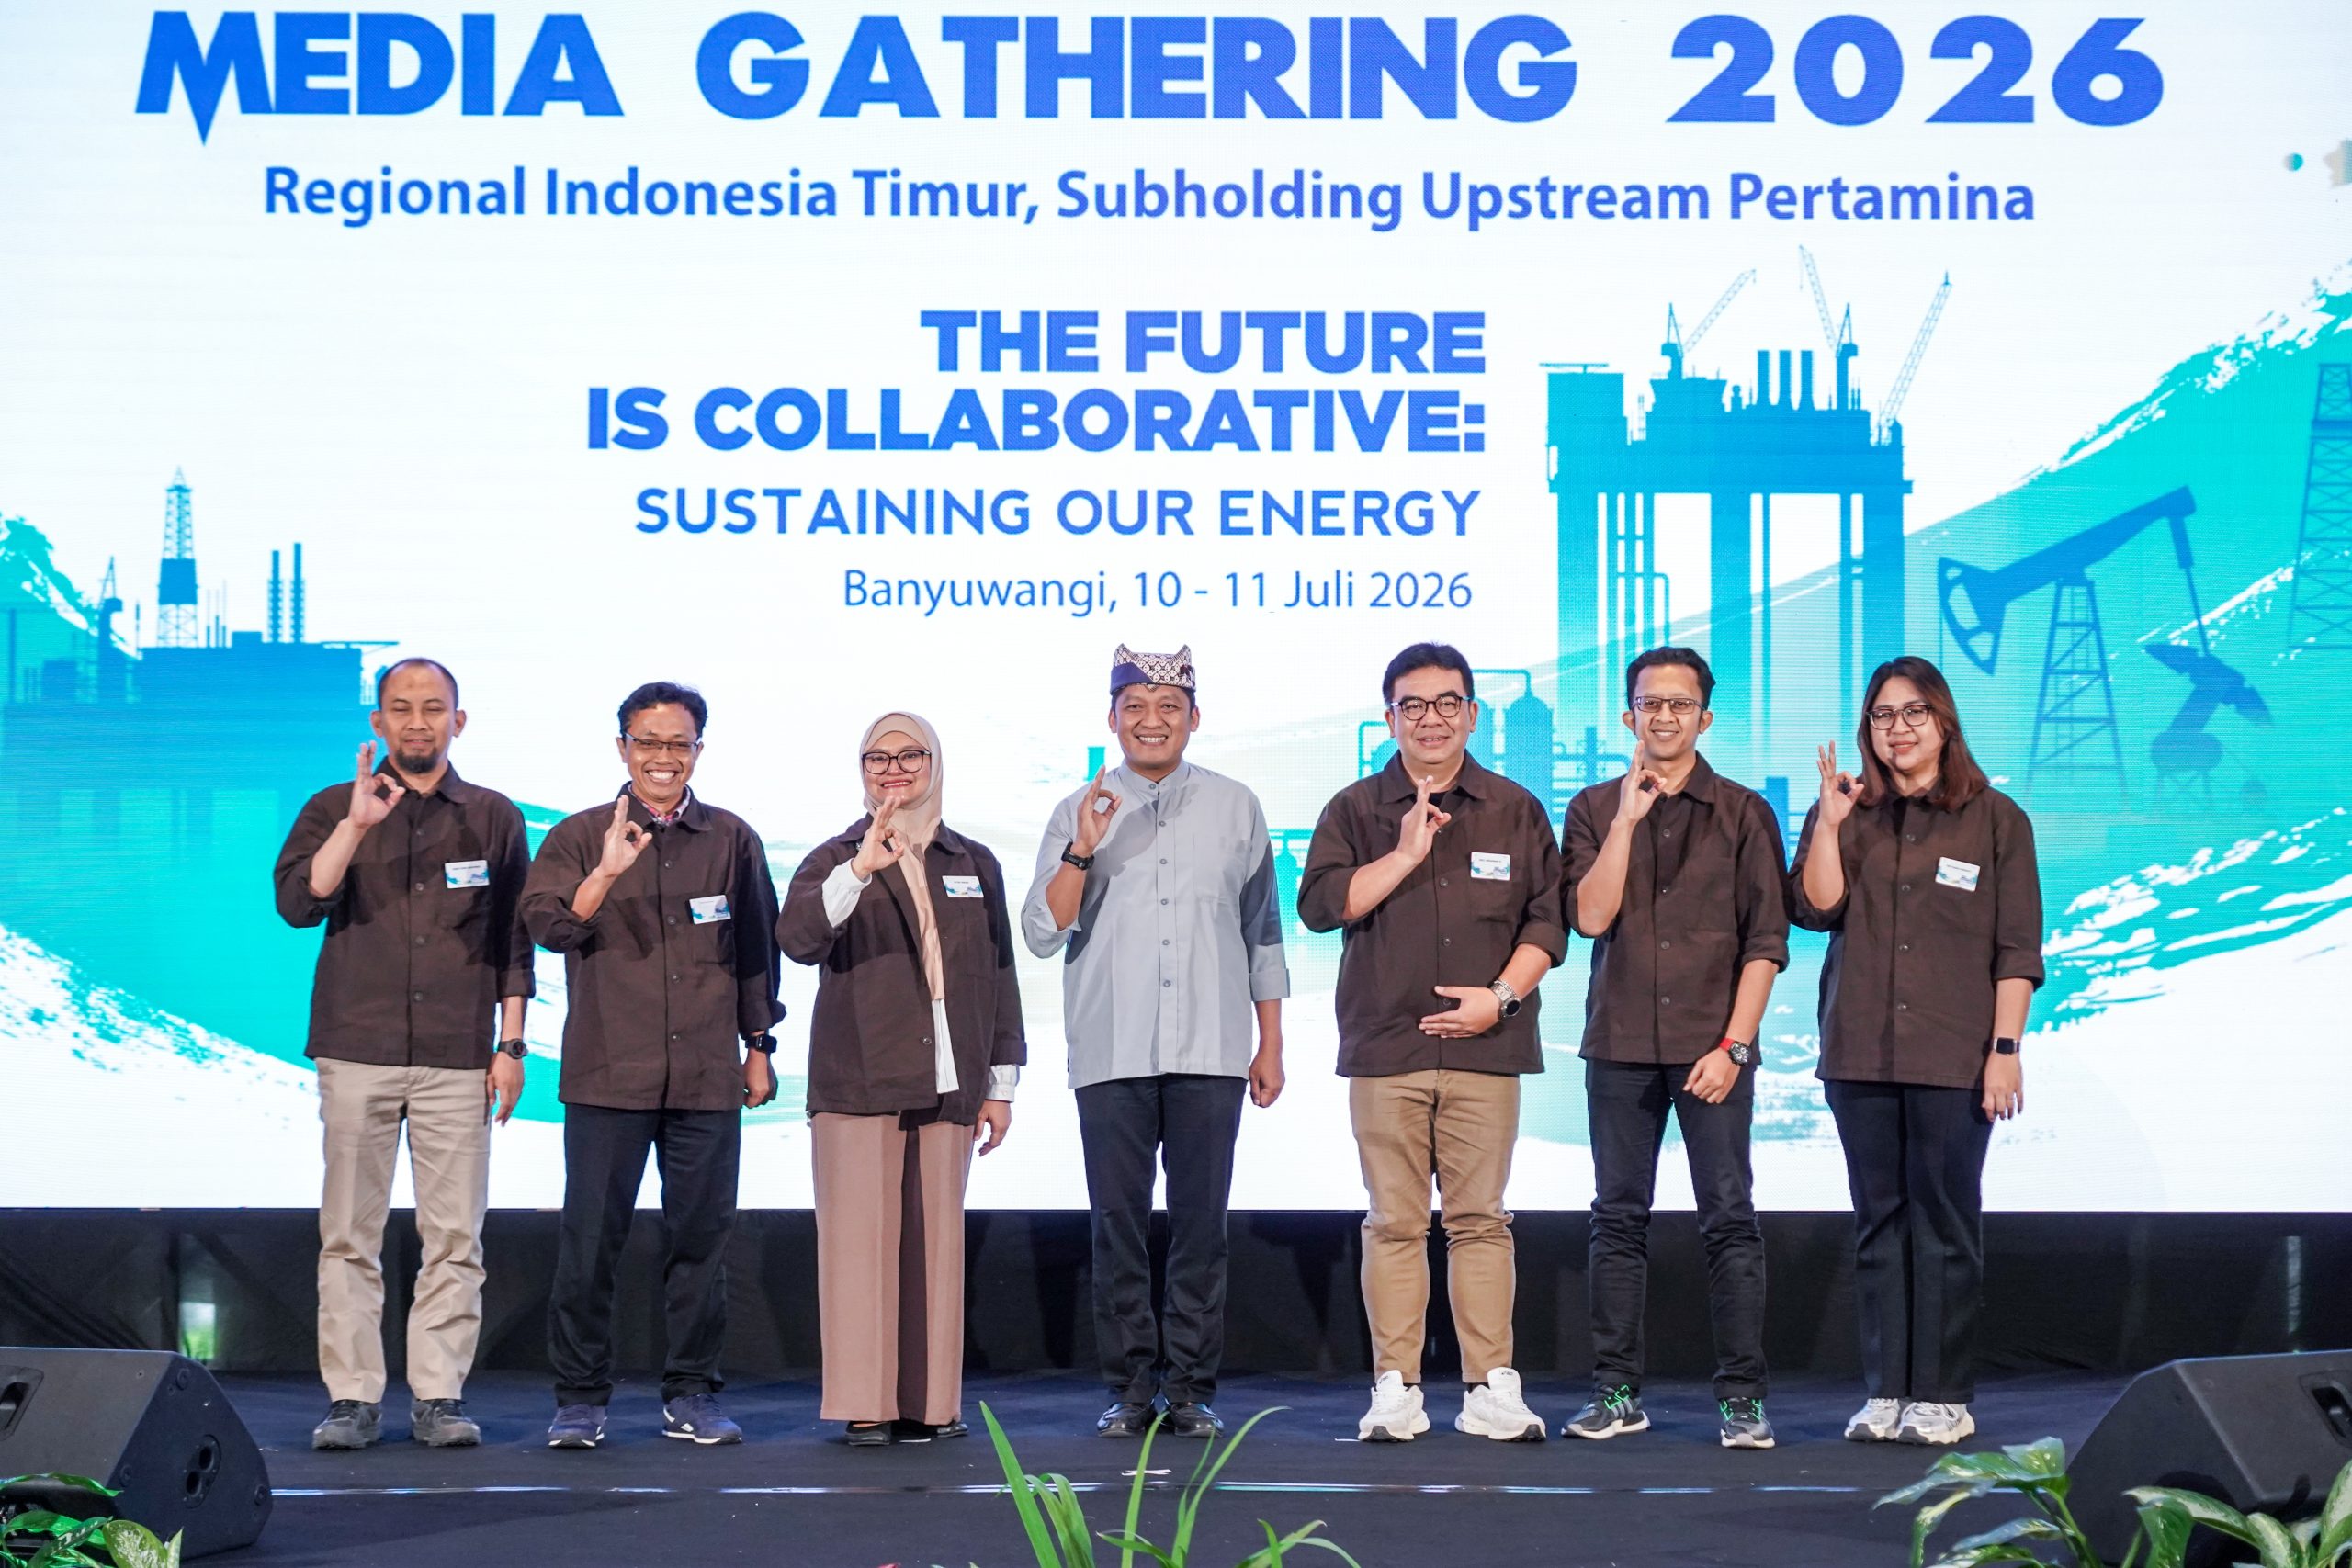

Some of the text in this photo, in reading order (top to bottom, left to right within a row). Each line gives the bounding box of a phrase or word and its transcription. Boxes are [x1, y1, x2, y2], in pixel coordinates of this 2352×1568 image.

[135, 10, 2165, 146] MEDIA GATHERING 2026
[265, 164, 2034, 233] Regional Indonesia Timur, Subholding Upstream Pertamina
[920, 310, 1486, 375] THE FUTURE
[587, 386, 1486, 454] IS COLLABORATIVE:
[635, 487, 1480, 536] SUSTAINING OUR ENERGY
[844, 569, 1117, 618] Banyuwangi,
[1134, 570, 1182, 608] 10
[1225, 571, 1265, 608] 11
[1283, 570, 1353, 610] Juli
[1369, 571, 1472, 609] 2026
